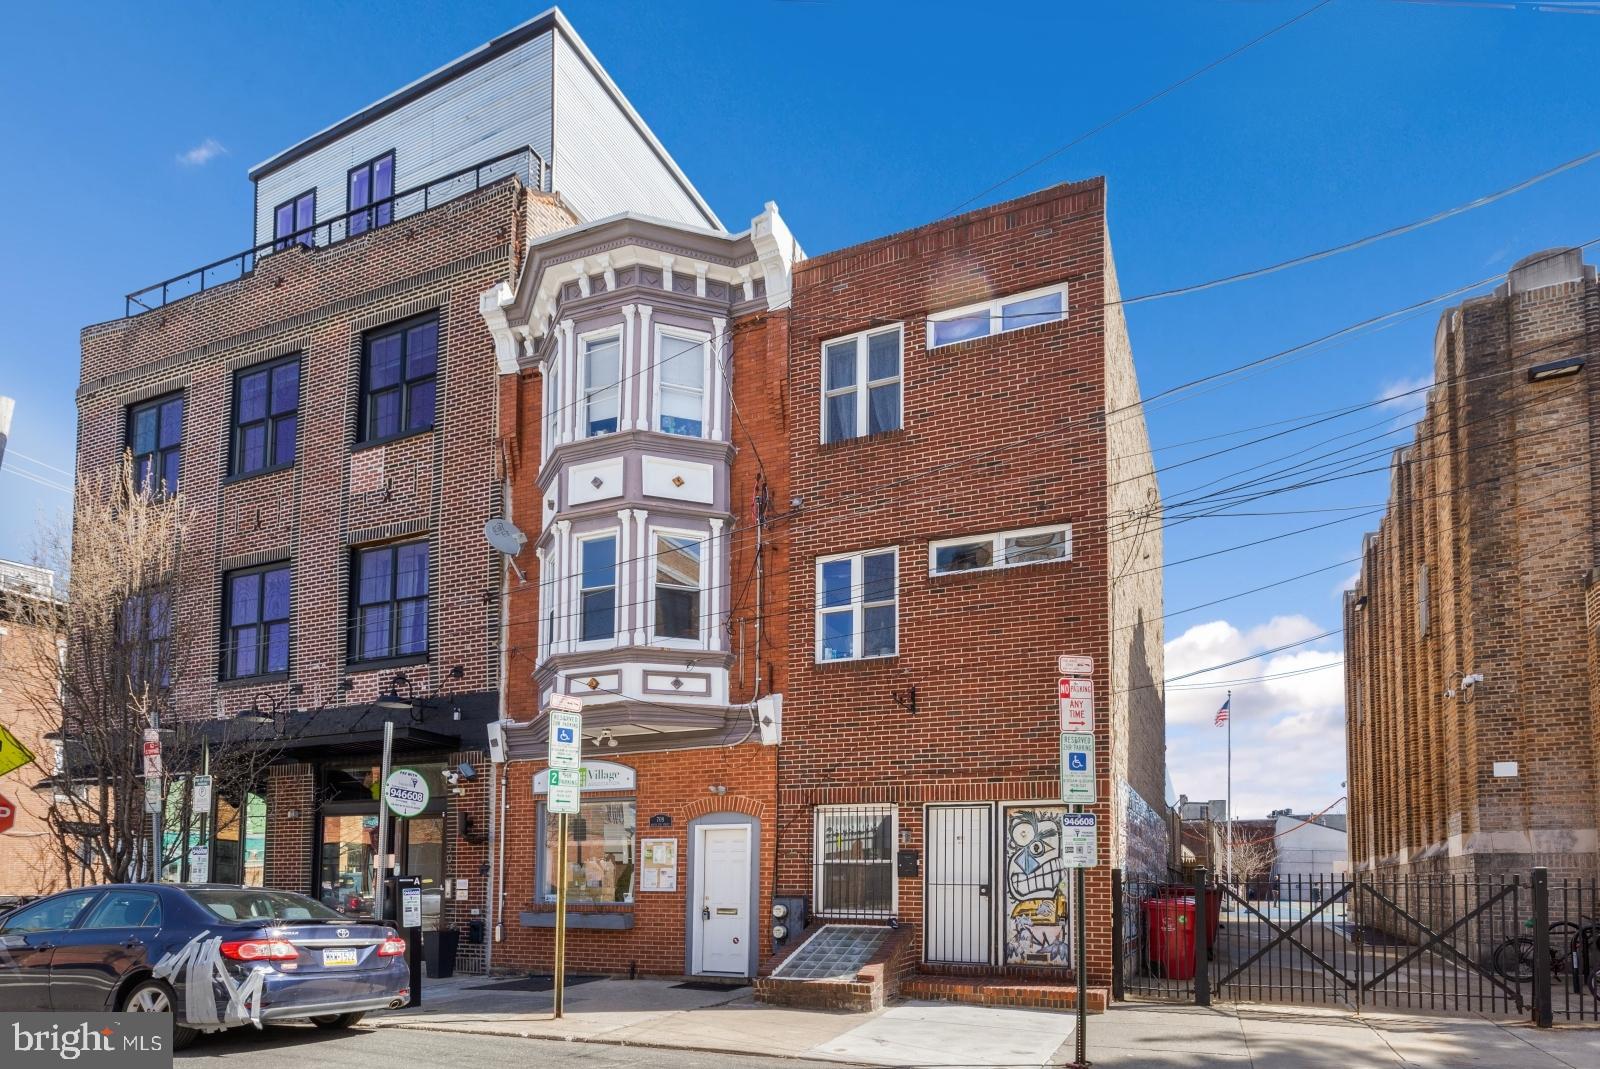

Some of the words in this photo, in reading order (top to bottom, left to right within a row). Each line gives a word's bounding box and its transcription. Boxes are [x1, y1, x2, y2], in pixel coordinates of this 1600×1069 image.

[1060, 683, 1070, 695] NO
[1070, 685, 1091, 693] PARKING
[1070, 699, 1084, 709] ANY
[1070, 709, 1086, 719] TIME
[1063, 735, 1091, 745] RESERVED
[1073, 744, 1092, 752] PARKING
[551, 772, 557, 784] 2
[588, 769, 620, 782] Village
[390, 788, 423, 802] 946608
[1064, 817, 1095, 826] 946608
[413, 877, 421, 886] A
